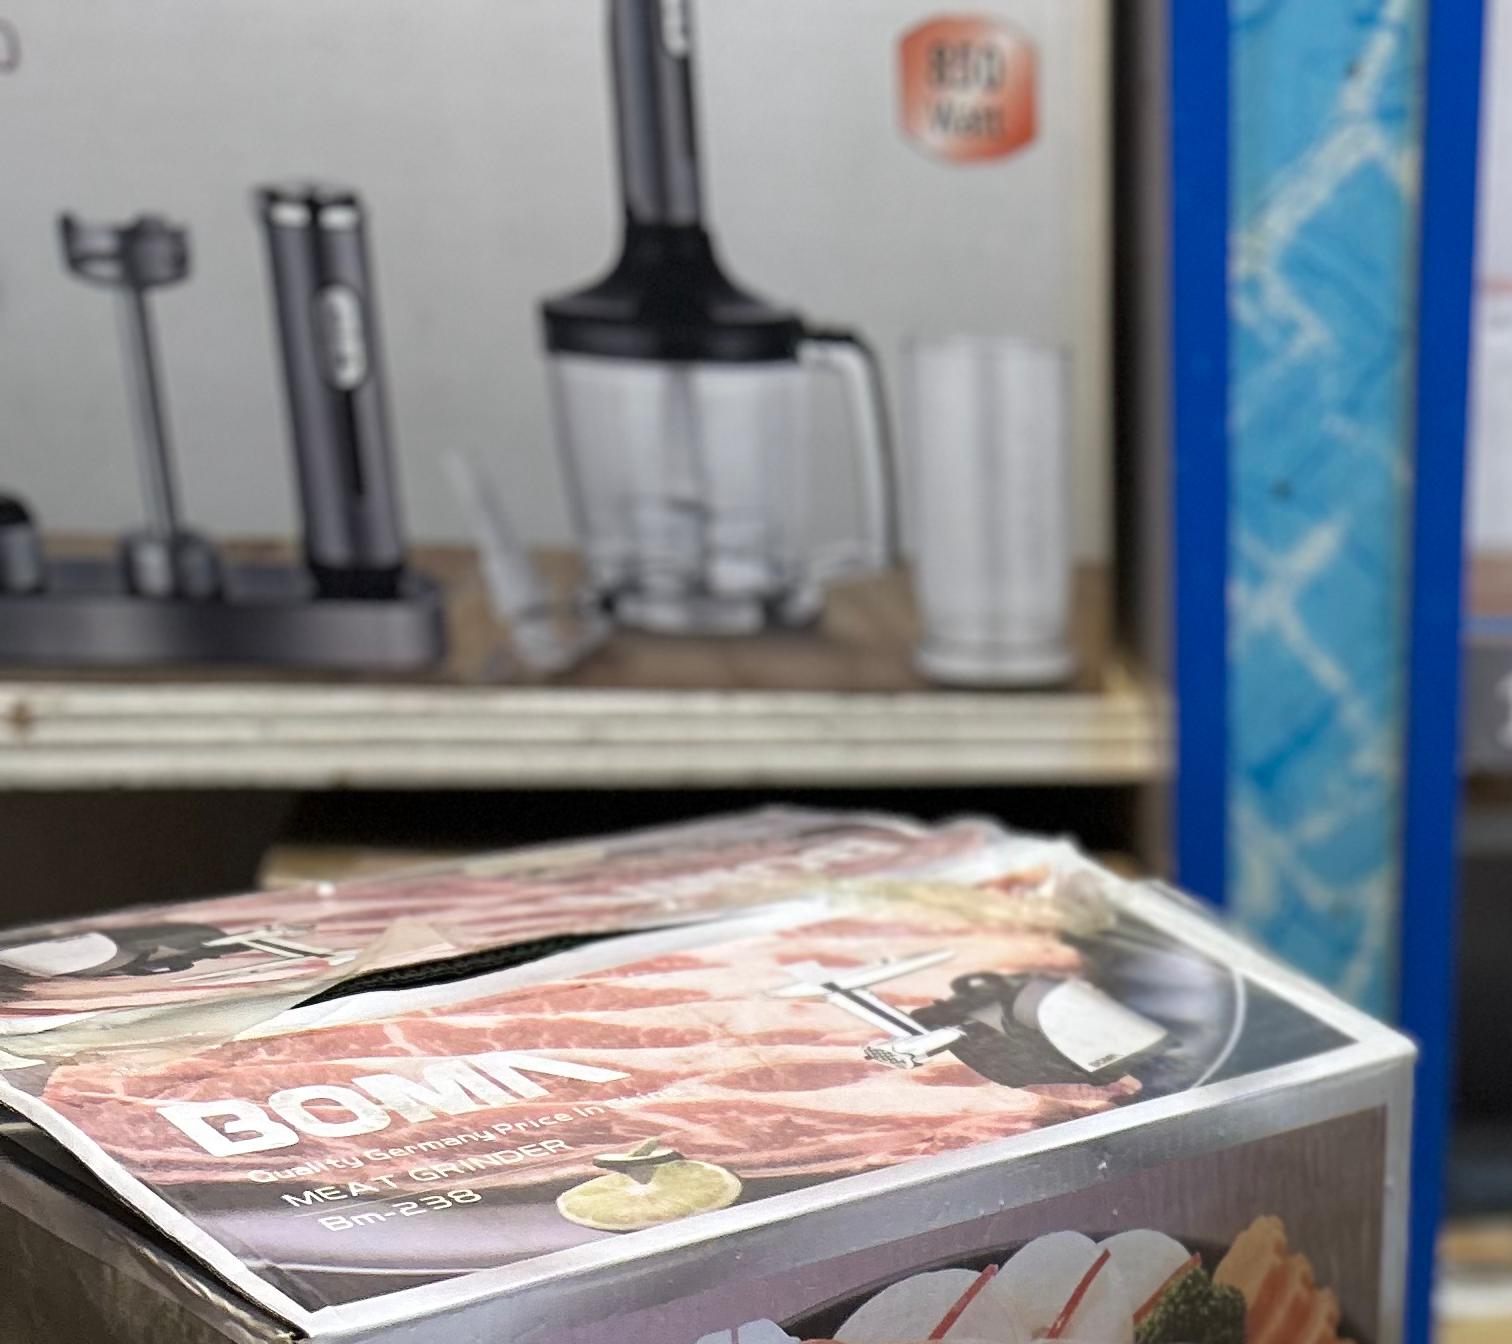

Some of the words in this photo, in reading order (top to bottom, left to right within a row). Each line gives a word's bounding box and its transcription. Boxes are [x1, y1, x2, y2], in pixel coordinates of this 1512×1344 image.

[158, 1052, 631, 1157] BOMA
[250, 1152, 363, 1184] Quality
[365, 1128, 496, 1164] Germany
[493, 1110, 573, 1141] Price
[573, 1104, 606, 1118] In
[282, 1164, 396, 1210] MEAT
[402, 1138, 574, 1183] GRINDER
[318, 1188, 483, 1235] Bm-238
